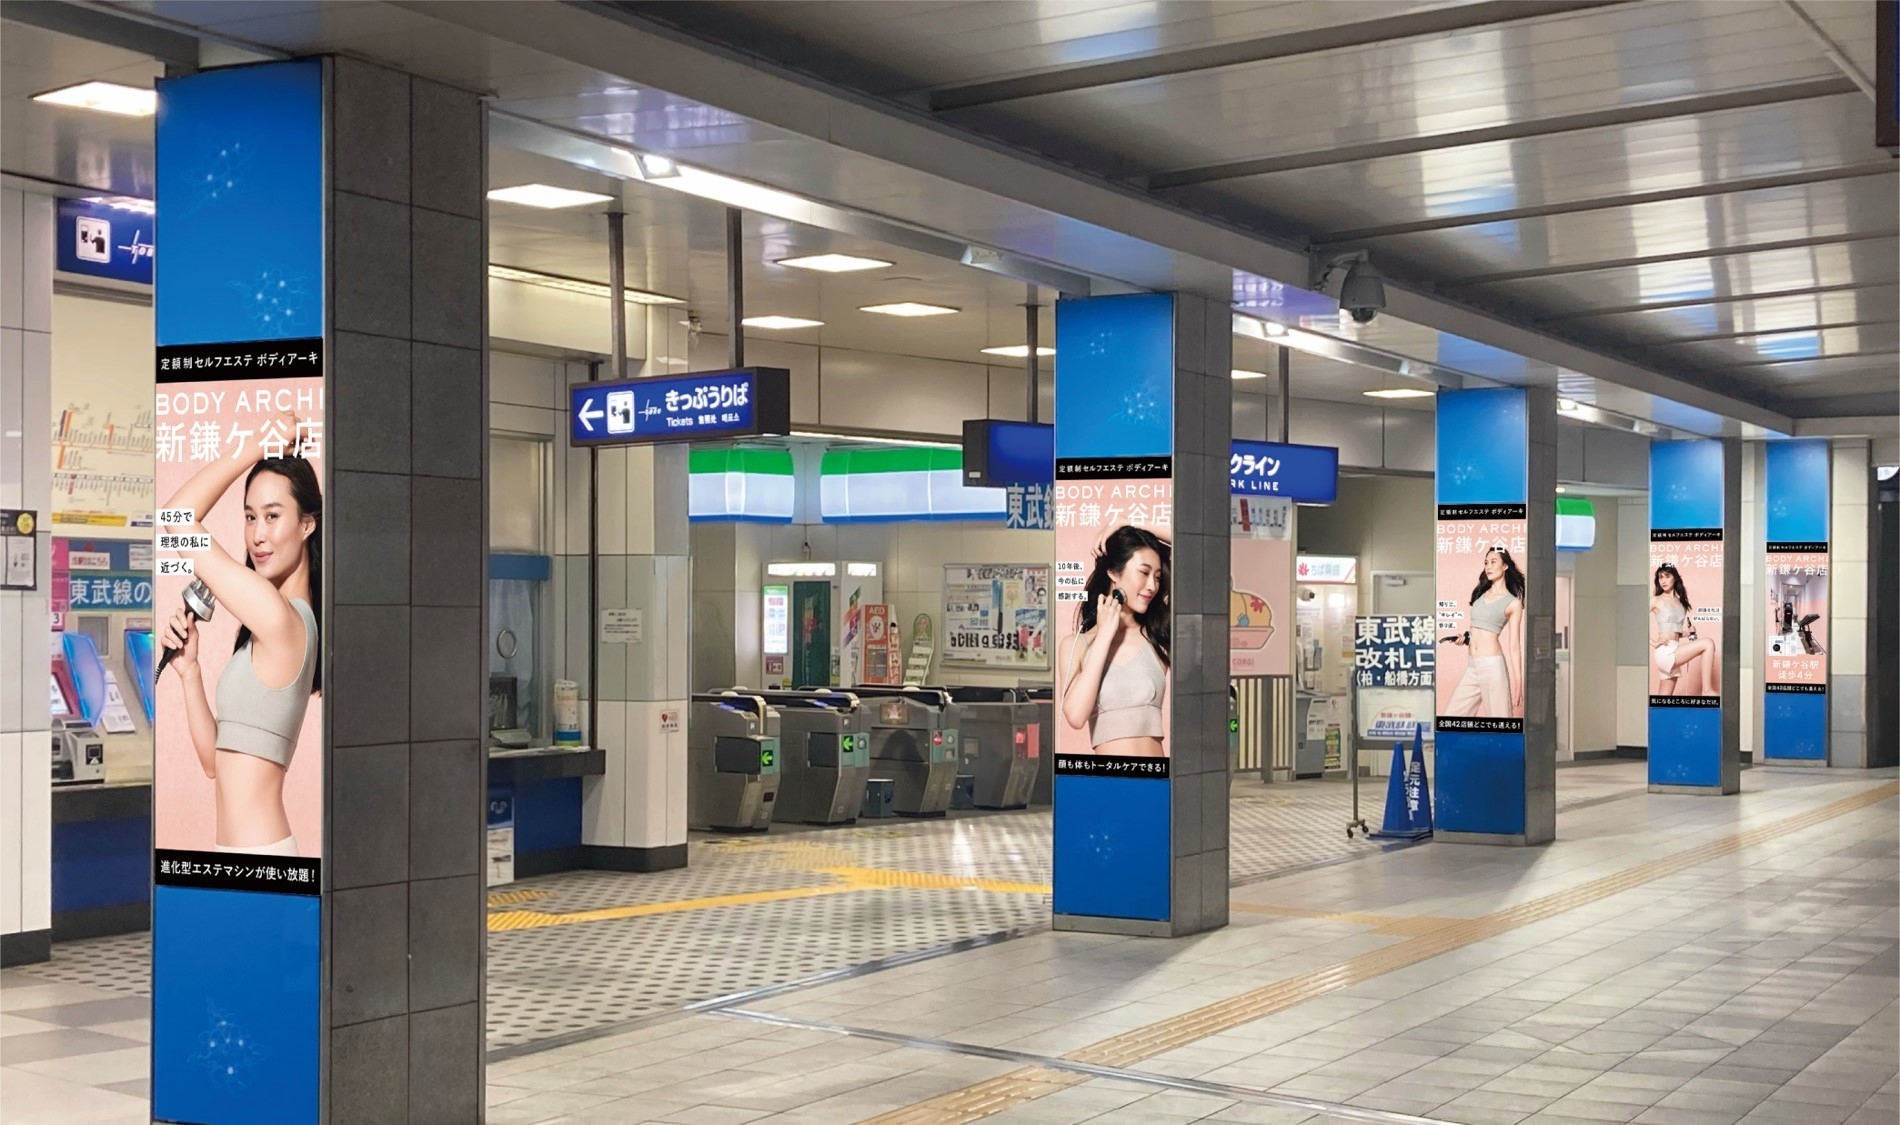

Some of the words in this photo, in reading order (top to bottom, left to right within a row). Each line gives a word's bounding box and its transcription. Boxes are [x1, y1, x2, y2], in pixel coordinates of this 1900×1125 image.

[161, 354, 252, 370] 定額制セルフエステ
[257, 352, 318, 366] ボディアーキ
[156, 391, 226, 416] BODY
[235, 387, 323, 413] ARCHI
[665, 382, 748, 412] きっぷうりば
[666, 417, 693, 428] Tickets
[156, 417, 323, 463] 新鎌ケ谷店
[1126, 463, 1168, 472] ボディアーキ
[1231, 453, 1280, 476] クライン
[1056, 485, 1104, 500] BODY
[1110, 484, 1172, 499] ARCHI
[1251, 480, 1279, 491] LINE
[161, 511, 192, 523] 45分で
[1056, 502, 1172, 528] 新鎌ケ谷店
[1437, 524, 1475, 534] BODY
[1480, 523, 1526, 534] ARCHI
[161, 537, 209, 548] 理想の私に
[1437, 536, 1526, 555] 新鎌ケ谷店
[1650, 544, 1681, 552] BODY
[1685, 544, 1723, 552] ARCHI
[1766, 555, 1792, 563] BODY
[1796, 555, 1828, 563] ARCHI
[161, 562, 192, 574] 近づく。
[1058, 577, 1084, 585] 今の私に
[70, 579, 153, 605] 東武線の
[869, 606, 885, 615] AED
[53, 613, 60, 624] 3
[1356, 616, 1434, 645] 東武線
[1356, 647, 1434, 669] 改札口
[161, 860, 315, 883] 進化型エステマシンが使い放題！
